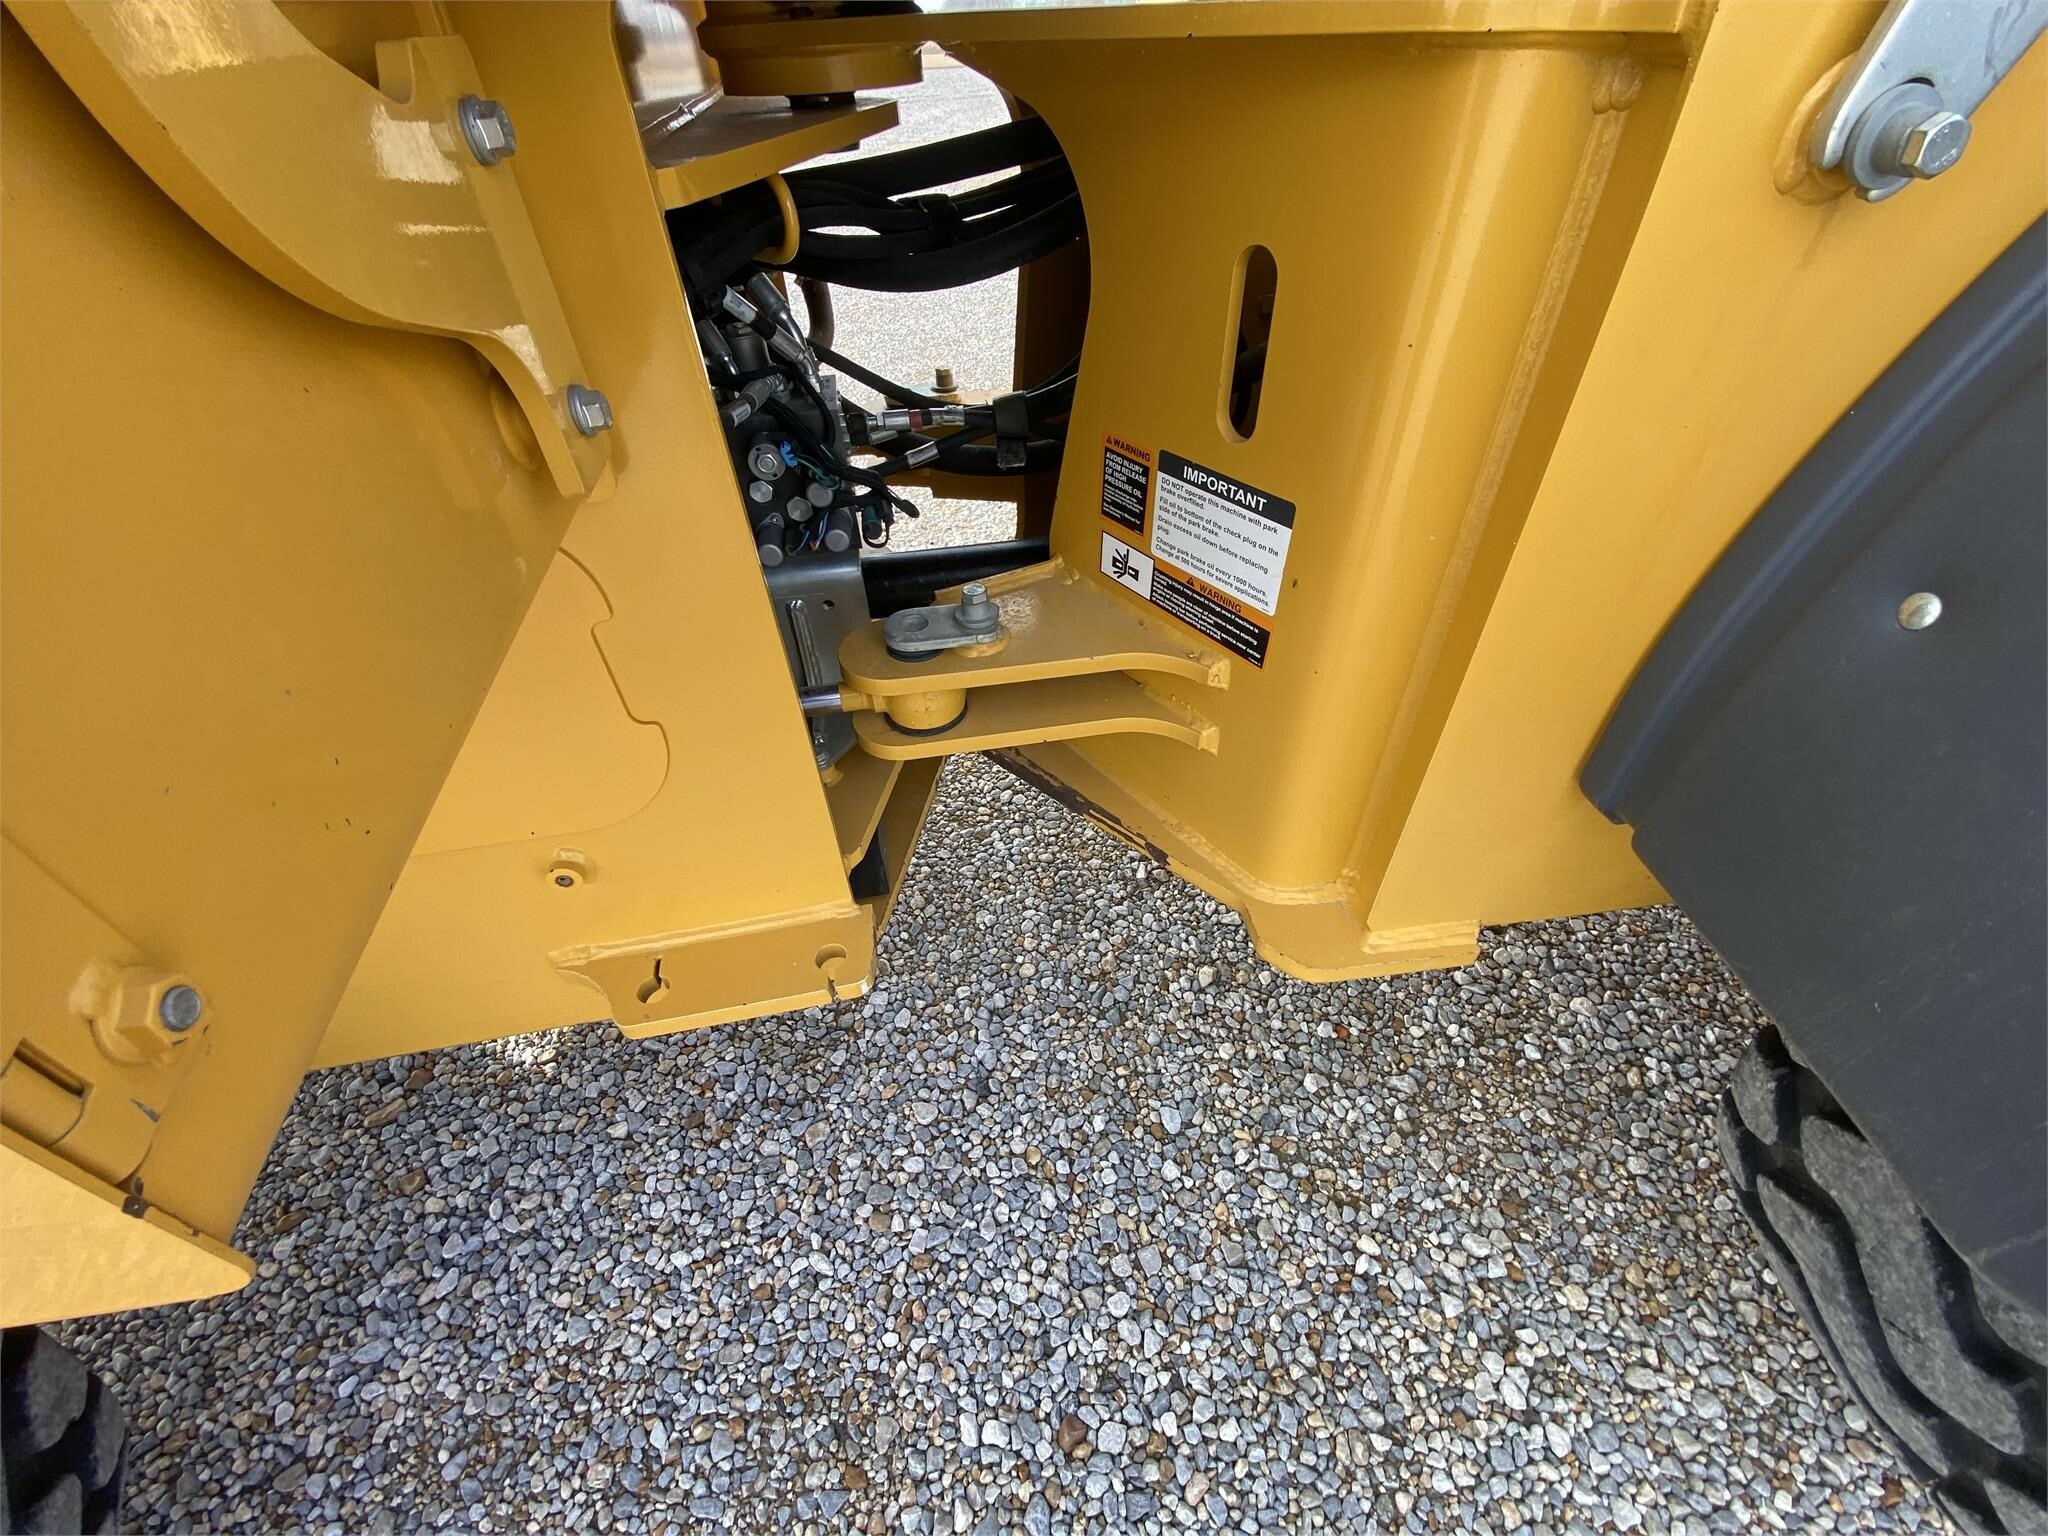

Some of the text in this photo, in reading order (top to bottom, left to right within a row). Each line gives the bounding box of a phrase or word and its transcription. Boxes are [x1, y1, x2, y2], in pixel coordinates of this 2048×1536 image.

[1106, 451, 1143, 474] AVOID INJURY
[1113, 438, 1150, 462] WARNING
[1104, 473, 1142, 498] PRESSURE OIL
[1105, 458, 1146, 484] FROM RELEASE
[1105, 465, 1126, 482] OF HIGH
[1160, 485, 1204, 510] brake overfilled.
[1182, 465, 1267, 512] IMPORTANT
[1161, 476, 1278, 535] DO NOT operate this machine with park
[1157, 524, 1169, 535] plug.
[1159, 504, 1219, 537] side of the park brake.
[1159, 496, 1168, 505] Fill
[1177, 504, 1182, 512] to
[1184, 507, 1204, 522] bottom
[1205, 517, 1211, 525] of
[1212, 521, 1222, 530] the
[1223, 526, 1241, 539] check
[1242, 535, 1256, 548] plug
[1258, 543, 1266, 551] on
[1267, 546, 1278, 557] the
[1158, 514, 1172, 526] Drain
[1173, 523, 1192, 536] excess
[1201, 536, 1217, 548] down
[1218, 544, 1237, 558] before
[1238, 554, 1268, 574] replacing
[1155, 543, 1173, 558] Change
[1180, 556, 1189, 565] 500
[1190, 561, 1205, 574] hours
[1206, 569, 1214, 578] for
[1215, 574, 1233, 588] severe
[1233, 583, 1269, 607] applications.
[1156, 536, 1267, 597] Change park brake oil every 1000 hours.
[1198, 584, 1242, 613] WARNING
